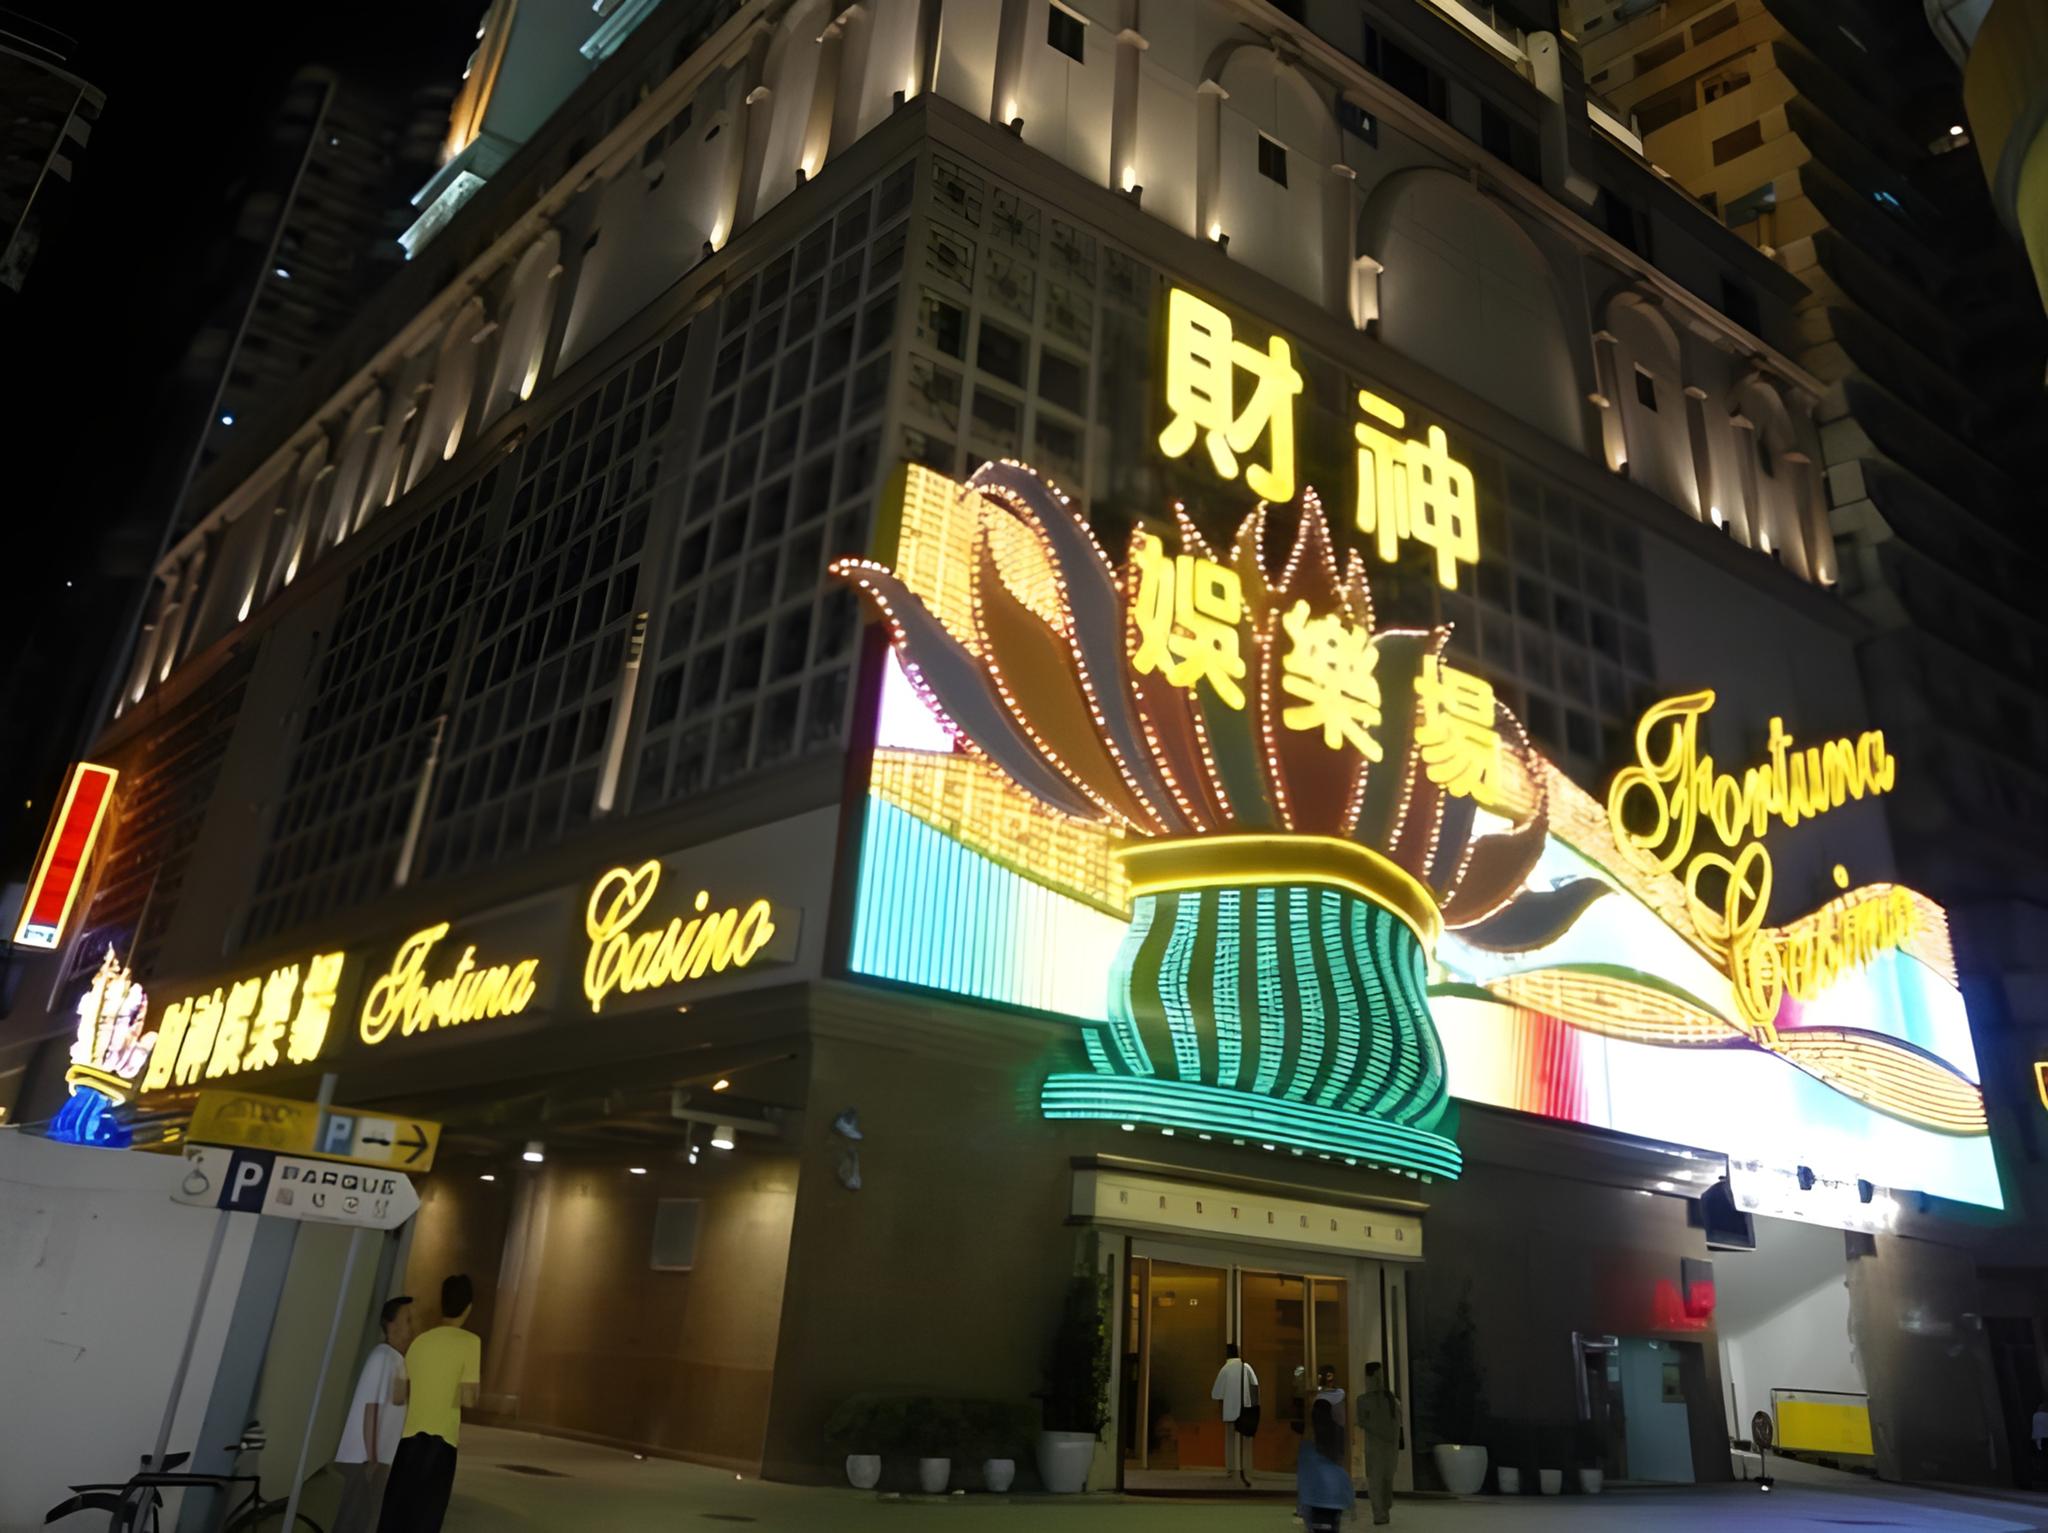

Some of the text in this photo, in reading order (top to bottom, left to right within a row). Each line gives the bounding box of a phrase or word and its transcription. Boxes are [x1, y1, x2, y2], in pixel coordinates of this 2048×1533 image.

[1158, 287, 1480, 590] 財神
[1608, 689, 1896, 873] Fortuna
[360, 859, 775, 1044] Fortuna Casino
[230, 1160, 265, 1203] P
